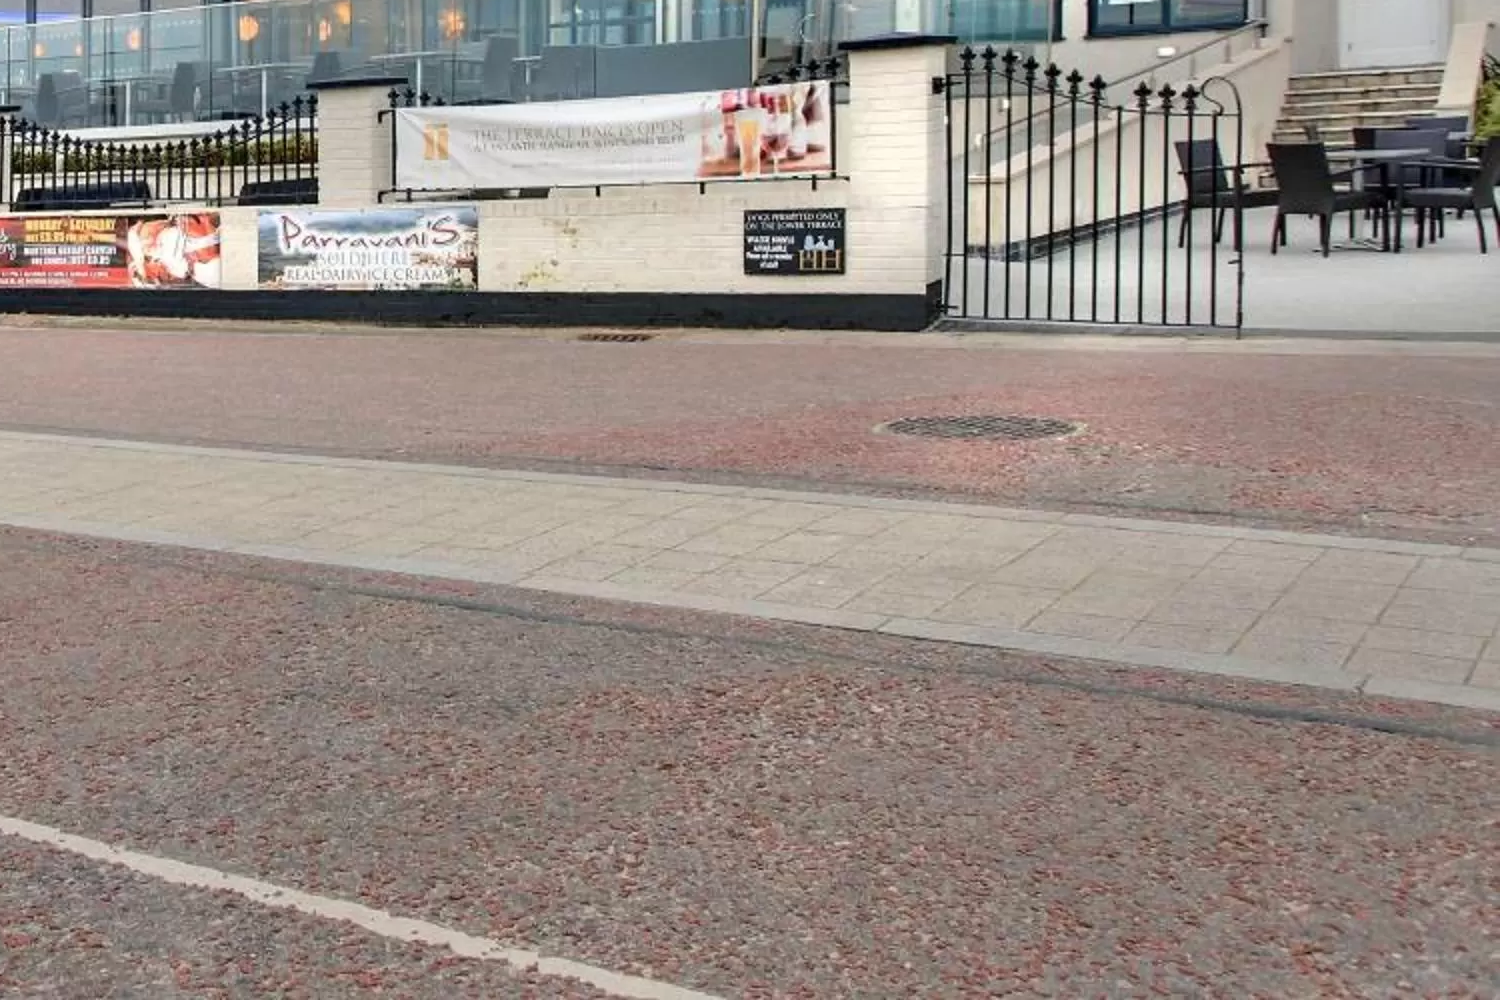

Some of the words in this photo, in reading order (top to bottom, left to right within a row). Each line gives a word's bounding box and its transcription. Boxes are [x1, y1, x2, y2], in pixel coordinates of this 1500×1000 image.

[636, 119, 684, 137] OPEN
[287, 268, 319, 282] REAL
[321, 268, 364, 282] DAIRY
[391, 267, 446, 282] CREAM
